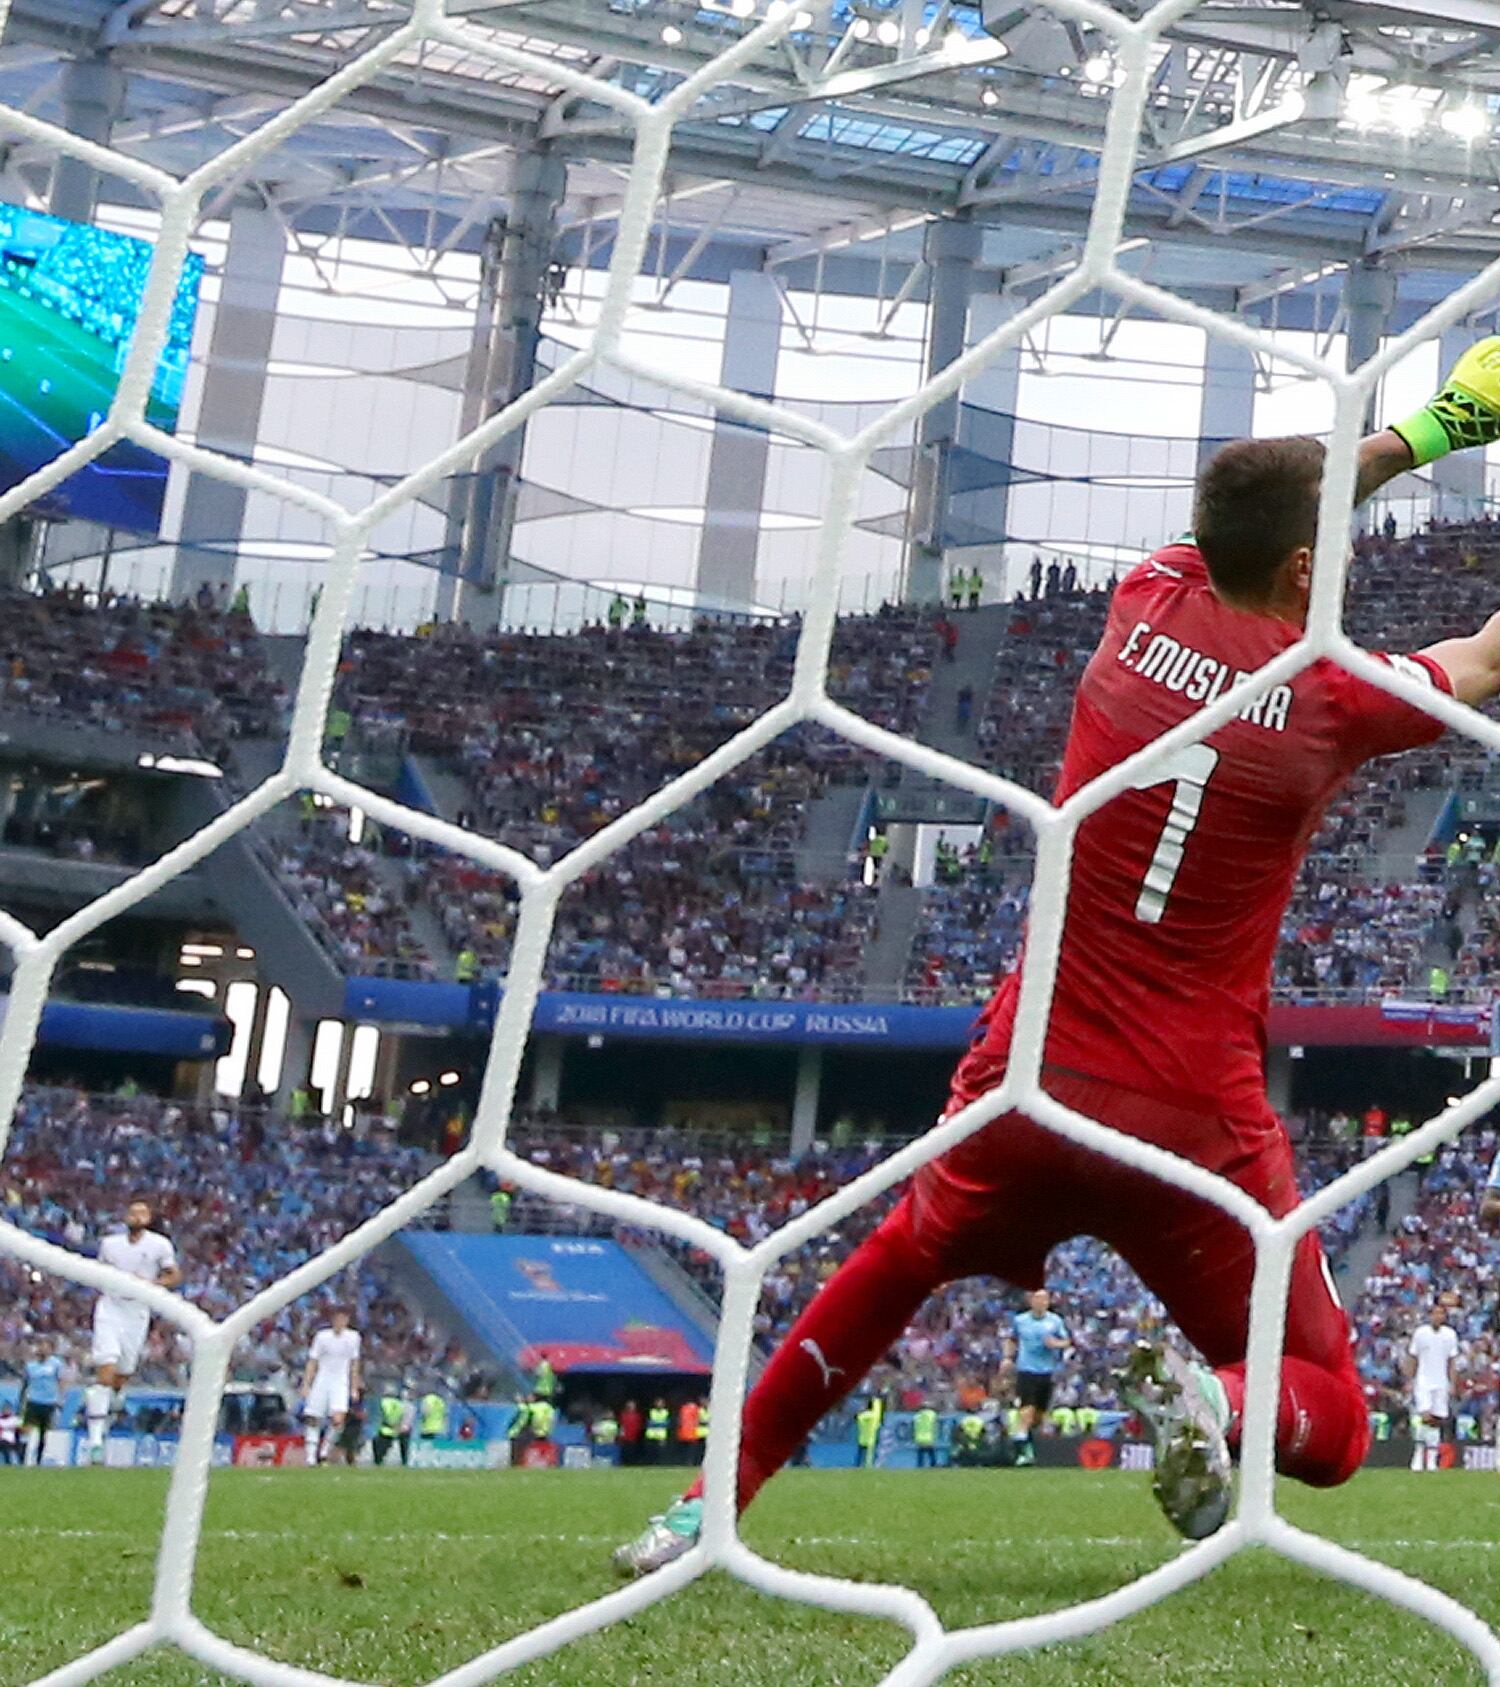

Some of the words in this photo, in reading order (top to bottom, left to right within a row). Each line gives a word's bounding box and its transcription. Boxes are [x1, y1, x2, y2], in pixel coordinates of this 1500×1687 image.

[610, 1005, 659, 1026] FIFA
[662, 1009, 744, 1031] WORLD
[747, 1013, 796, 1032] CUP
[805, 1013, 888, 1034] RUSSIA
